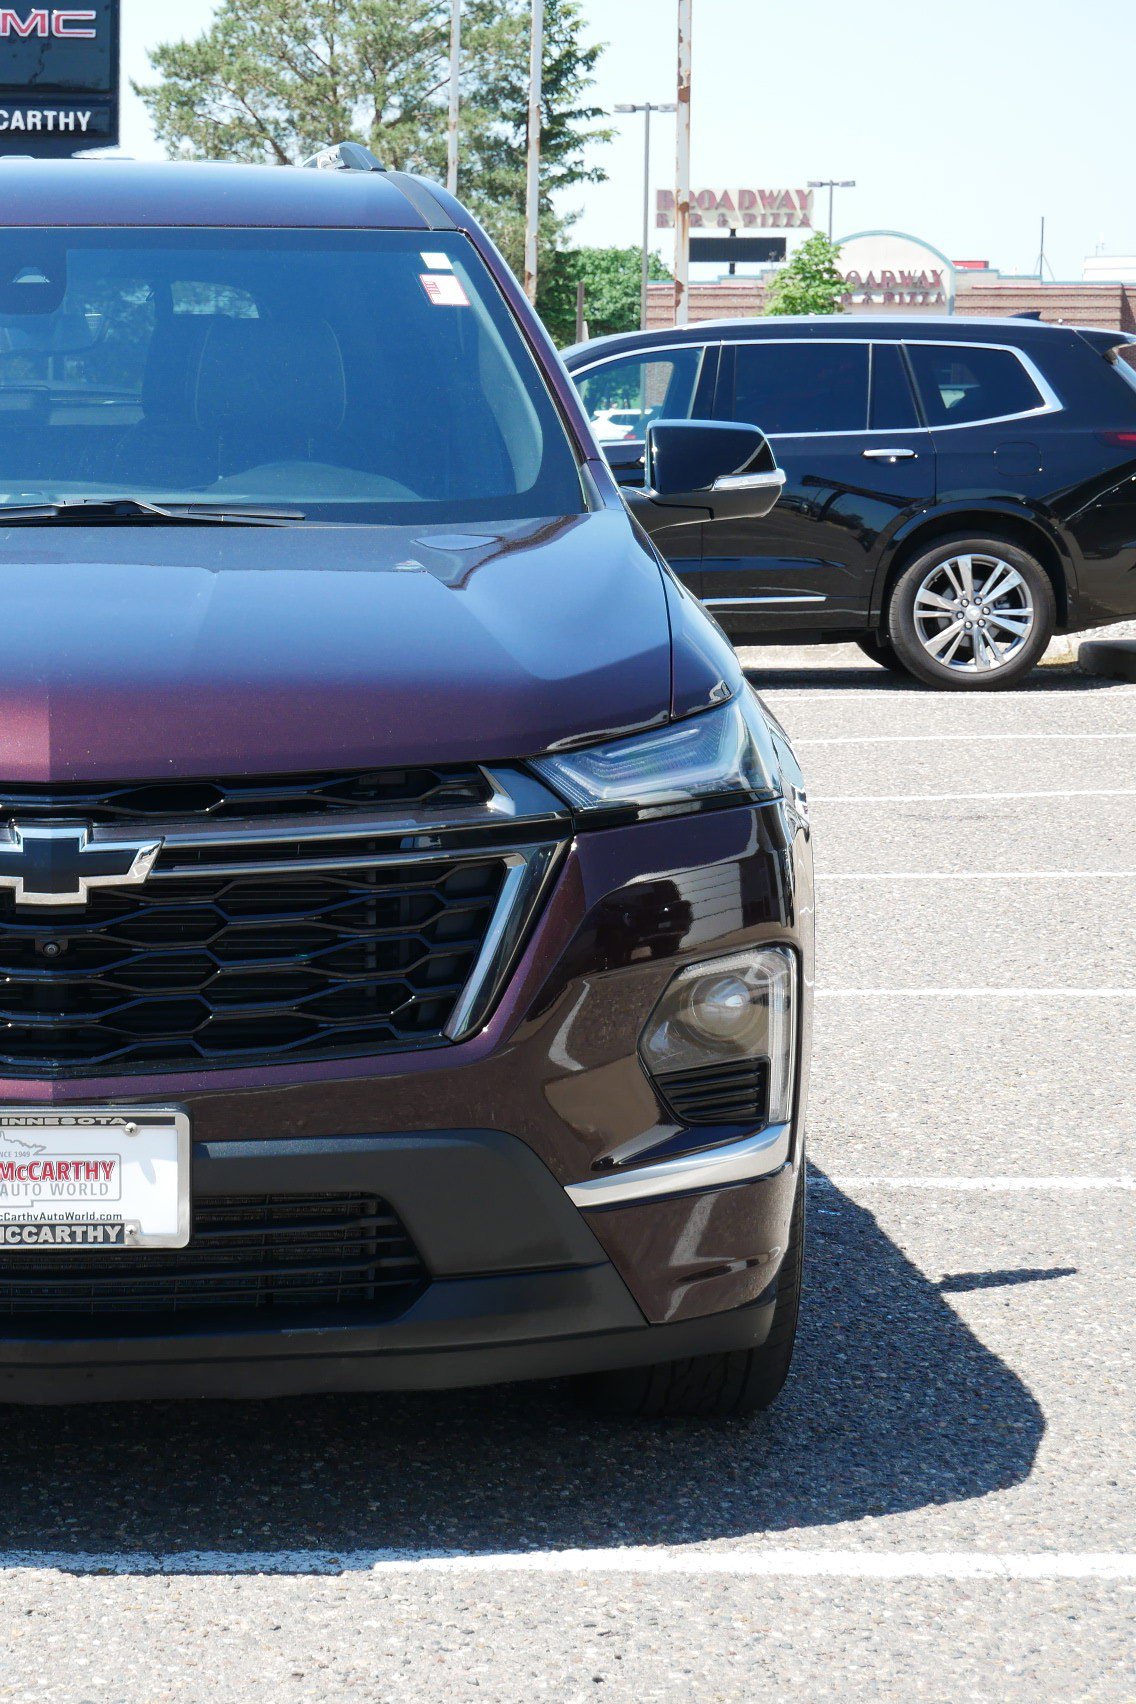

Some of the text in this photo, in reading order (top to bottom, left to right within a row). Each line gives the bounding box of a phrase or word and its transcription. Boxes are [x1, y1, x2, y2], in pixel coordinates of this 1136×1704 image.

[657, 212, 812, 228] BR & PIZZA
[883, 291, 945, 306] PIZZA
[0, 1183, 109, 1197] AUTO WORLD
